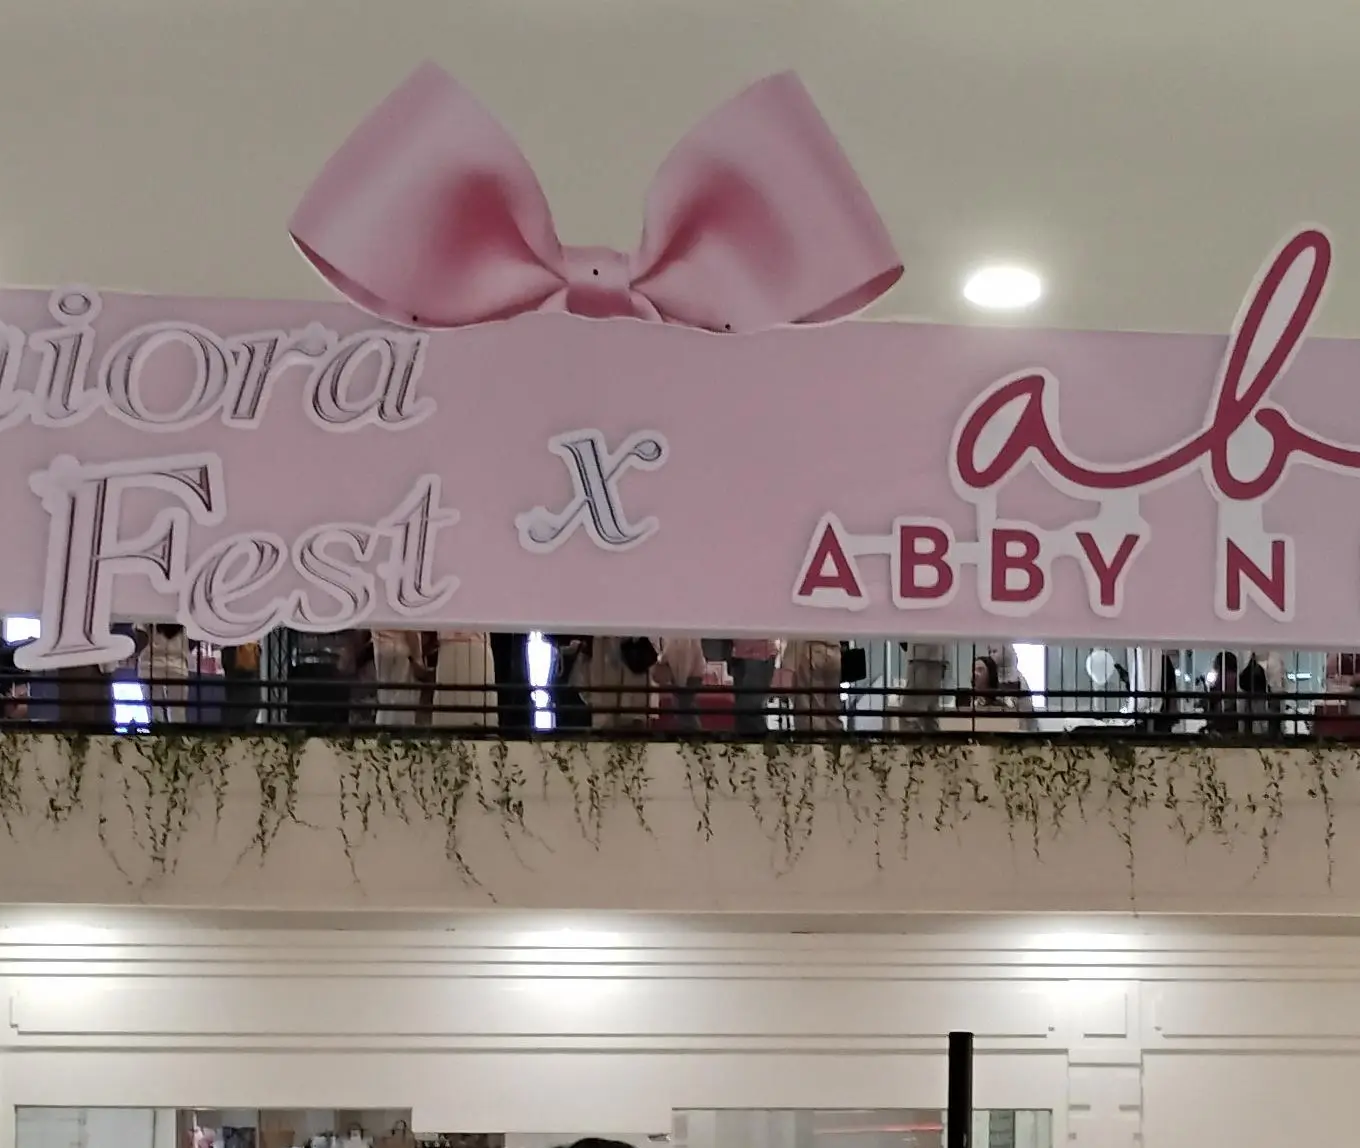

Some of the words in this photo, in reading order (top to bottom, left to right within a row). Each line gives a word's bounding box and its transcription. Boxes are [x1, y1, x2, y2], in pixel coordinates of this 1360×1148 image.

[42, 461, 453, 658] Fest
[798, 523, 1140, 608] ABBY
[1226, 536, 1287, 614] N
